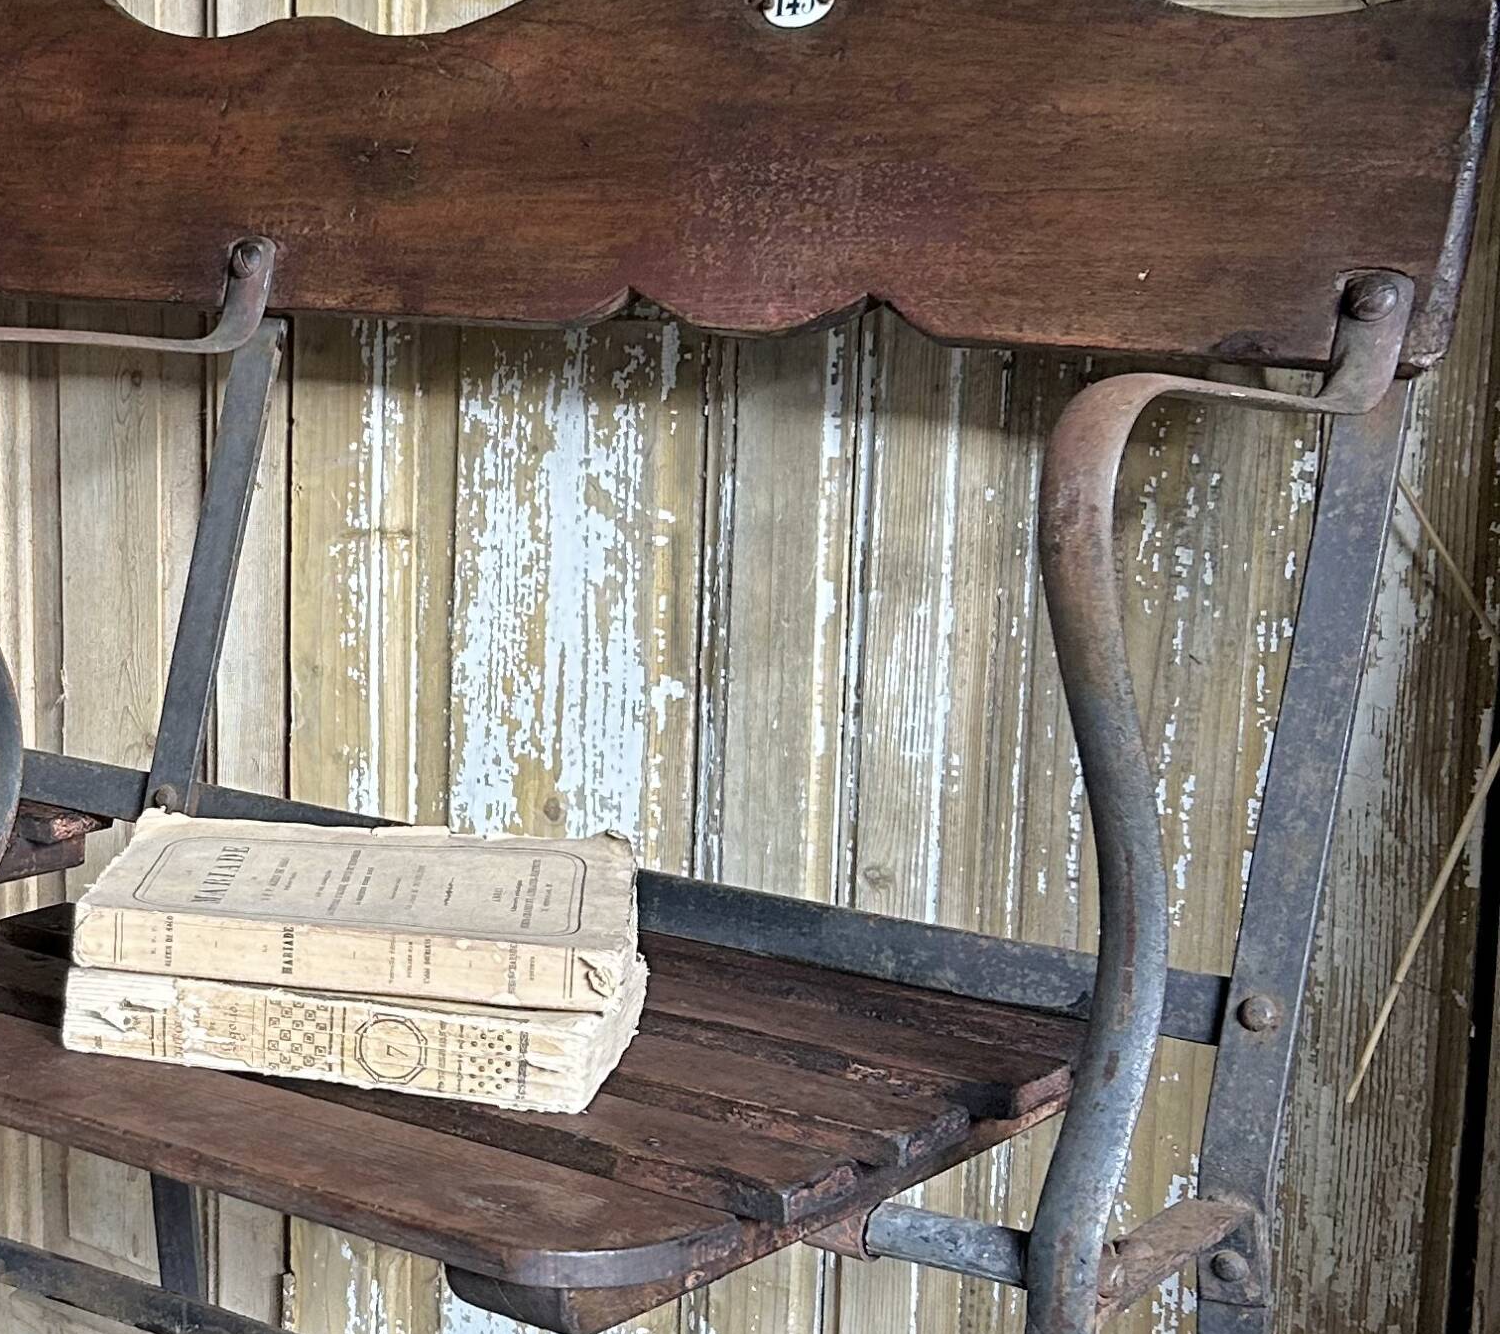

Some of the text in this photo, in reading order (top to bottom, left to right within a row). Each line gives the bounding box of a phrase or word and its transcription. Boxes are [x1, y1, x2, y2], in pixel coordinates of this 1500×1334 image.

[189, 845, 250, 905] MARIADE
[281, 925, 294, 974] MARIADE
[385, 1044, 409, 1058] 7
